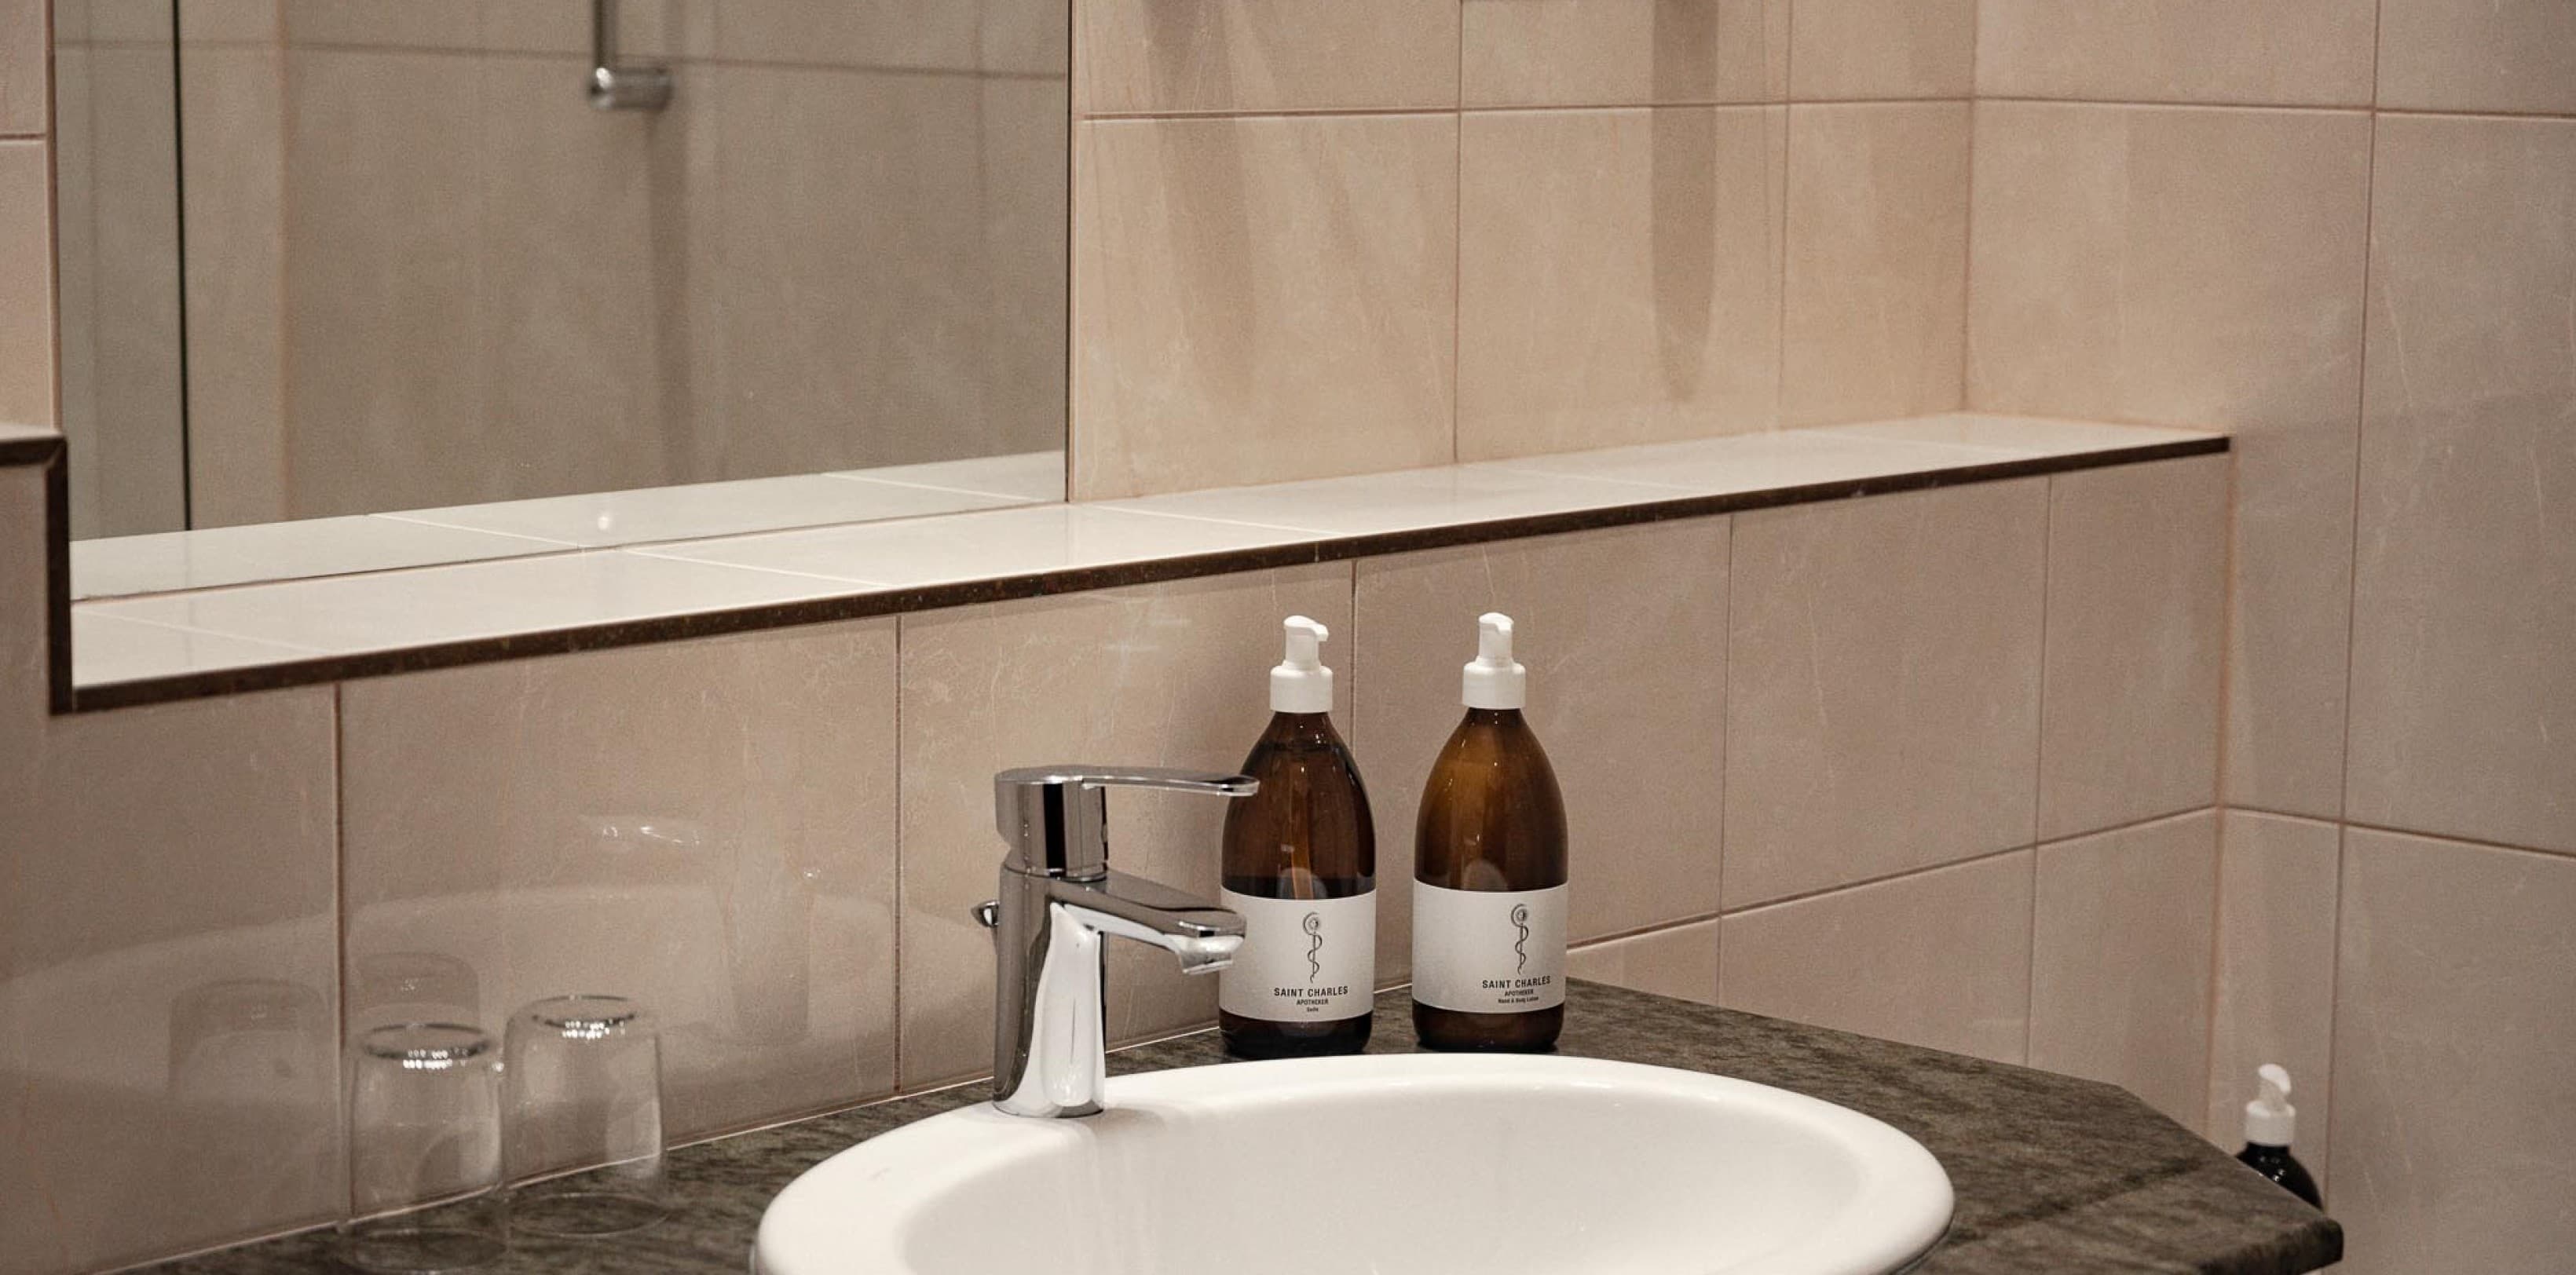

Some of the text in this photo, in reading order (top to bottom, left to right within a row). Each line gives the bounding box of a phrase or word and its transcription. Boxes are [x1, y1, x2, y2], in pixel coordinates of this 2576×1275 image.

[1482, 975, 1551, 988] SAINT CHARLES
[1274, 986, 1348, 997] SAINT CHARLES
